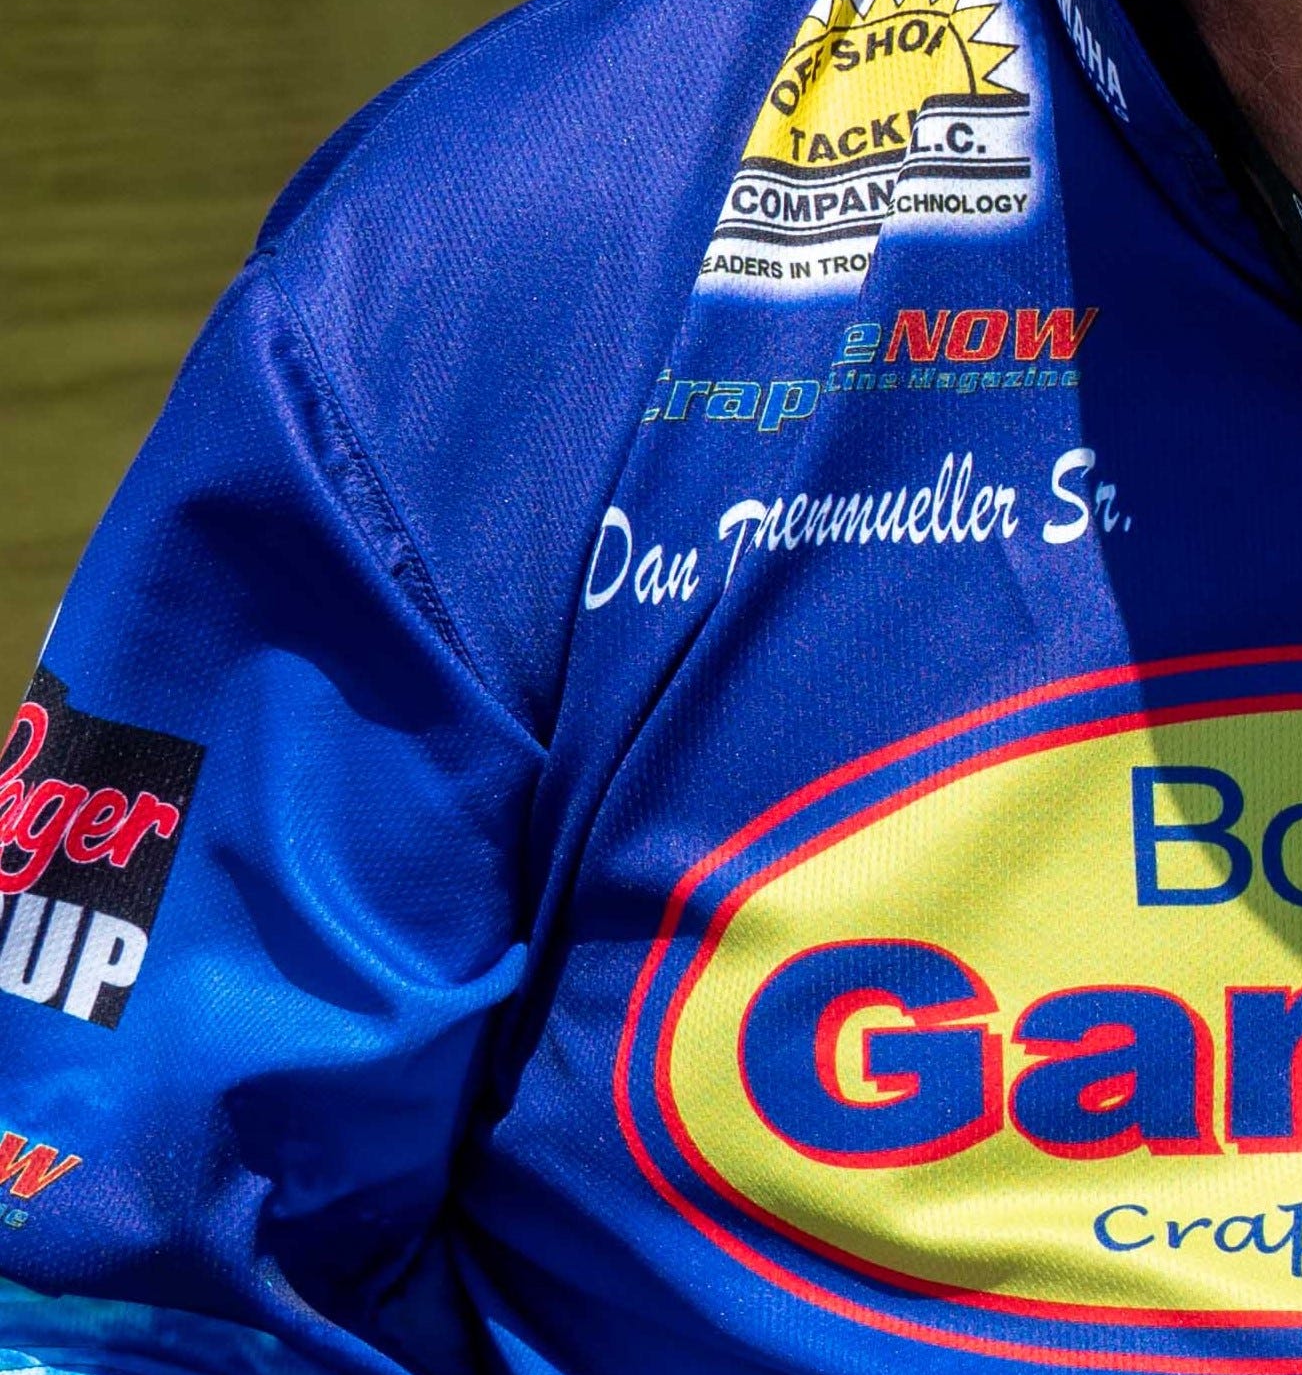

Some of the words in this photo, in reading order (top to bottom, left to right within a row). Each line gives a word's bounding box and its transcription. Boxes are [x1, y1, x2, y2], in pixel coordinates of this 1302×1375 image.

[790, 261, 811, 280] IN
[817, 253, 872, 275] TRO
[642, 368, 820, 432] rap
[908, 368, 1081, 394] Magazine
[585, 505, 700, 610] Dan
[1042, 447, 1132, 544] Sr.
